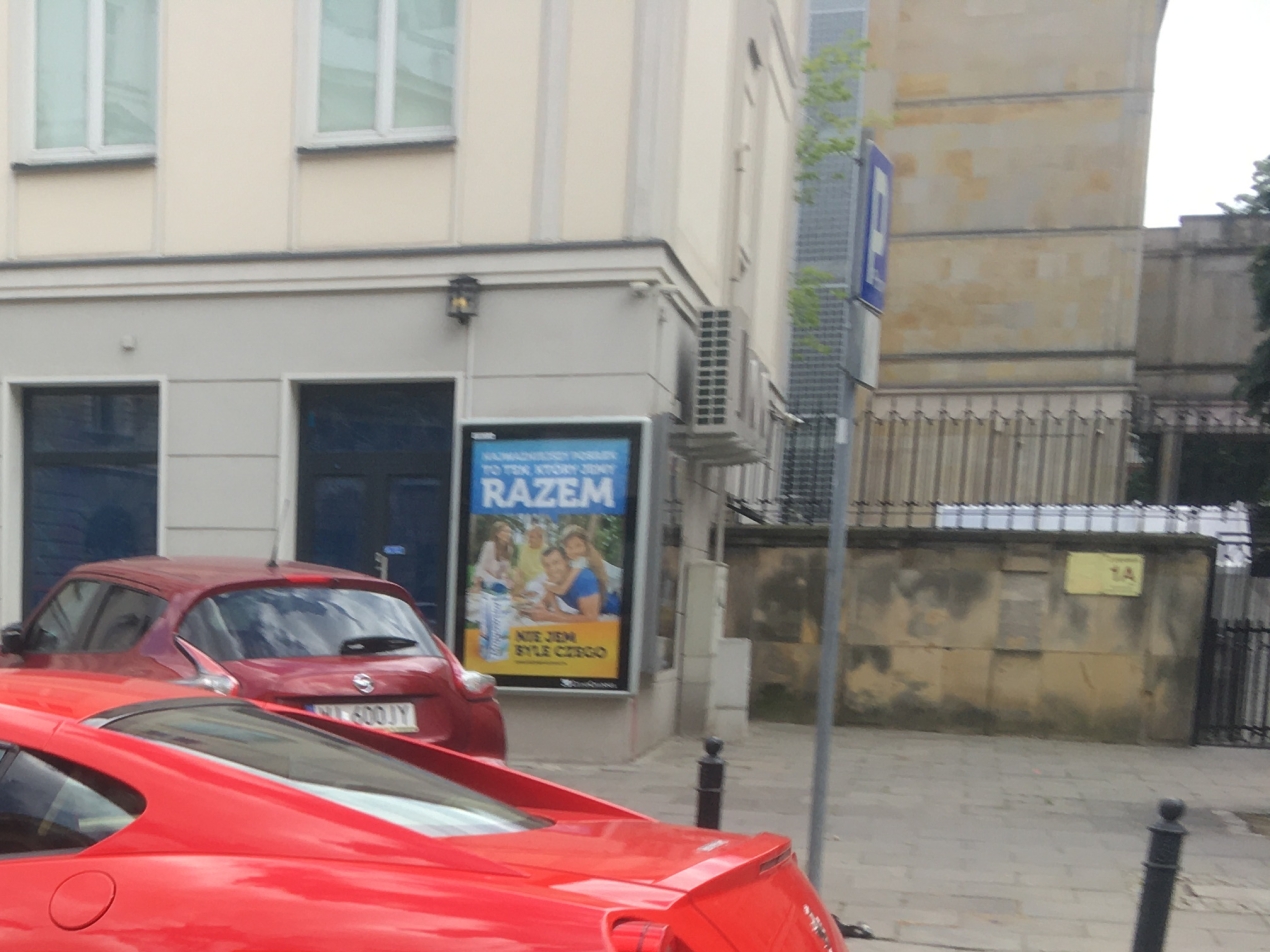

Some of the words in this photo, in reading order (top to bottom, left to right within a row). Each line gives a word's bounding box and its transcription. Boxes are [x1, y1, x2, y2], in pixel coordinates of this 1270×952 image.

[481, 477, 616, 508] RAZEM
[515, 630, 542, 643] NIE
[545, 631, 577, 643] JEM
[515, 644, 550, 658] BYLE
[554, 645, 608, 659] CZEGO
